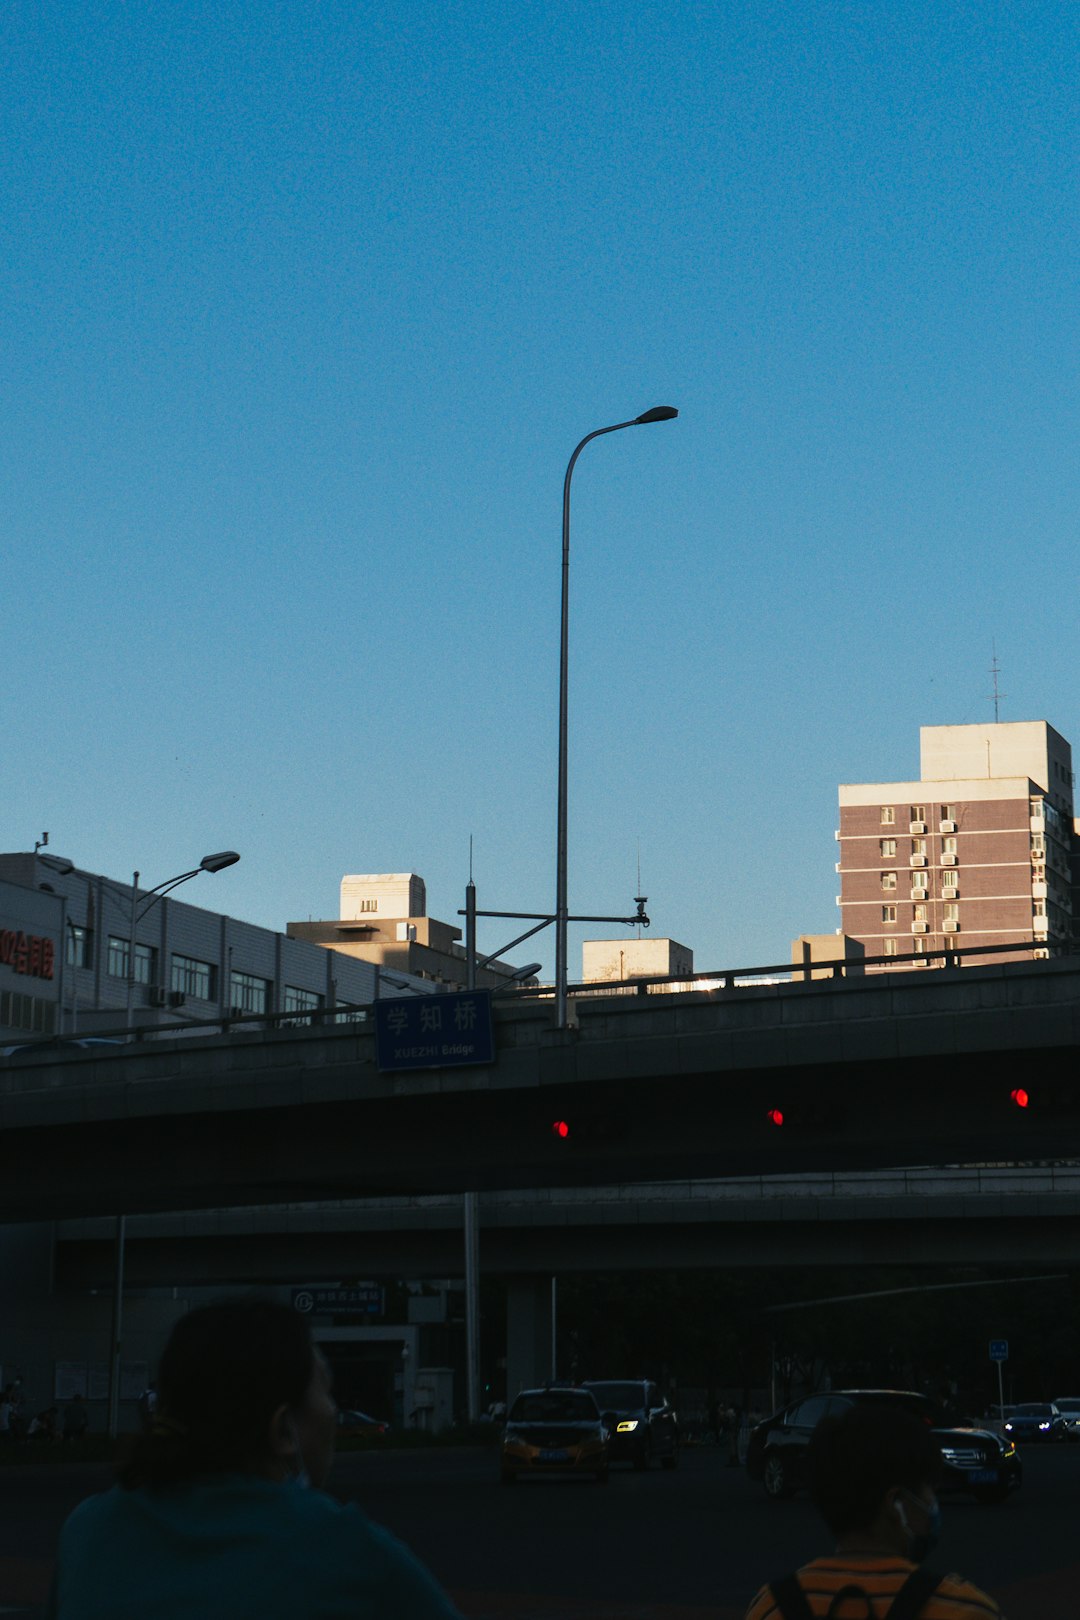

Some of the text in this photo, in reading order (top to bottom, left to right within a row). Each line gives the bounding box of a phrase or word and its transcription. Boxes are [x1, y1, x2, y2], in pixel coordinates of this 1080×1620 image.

[386, 1000, 478, 1036] 学知桥
[393, 1043, 475, 1059] XUEZHI Bridge
